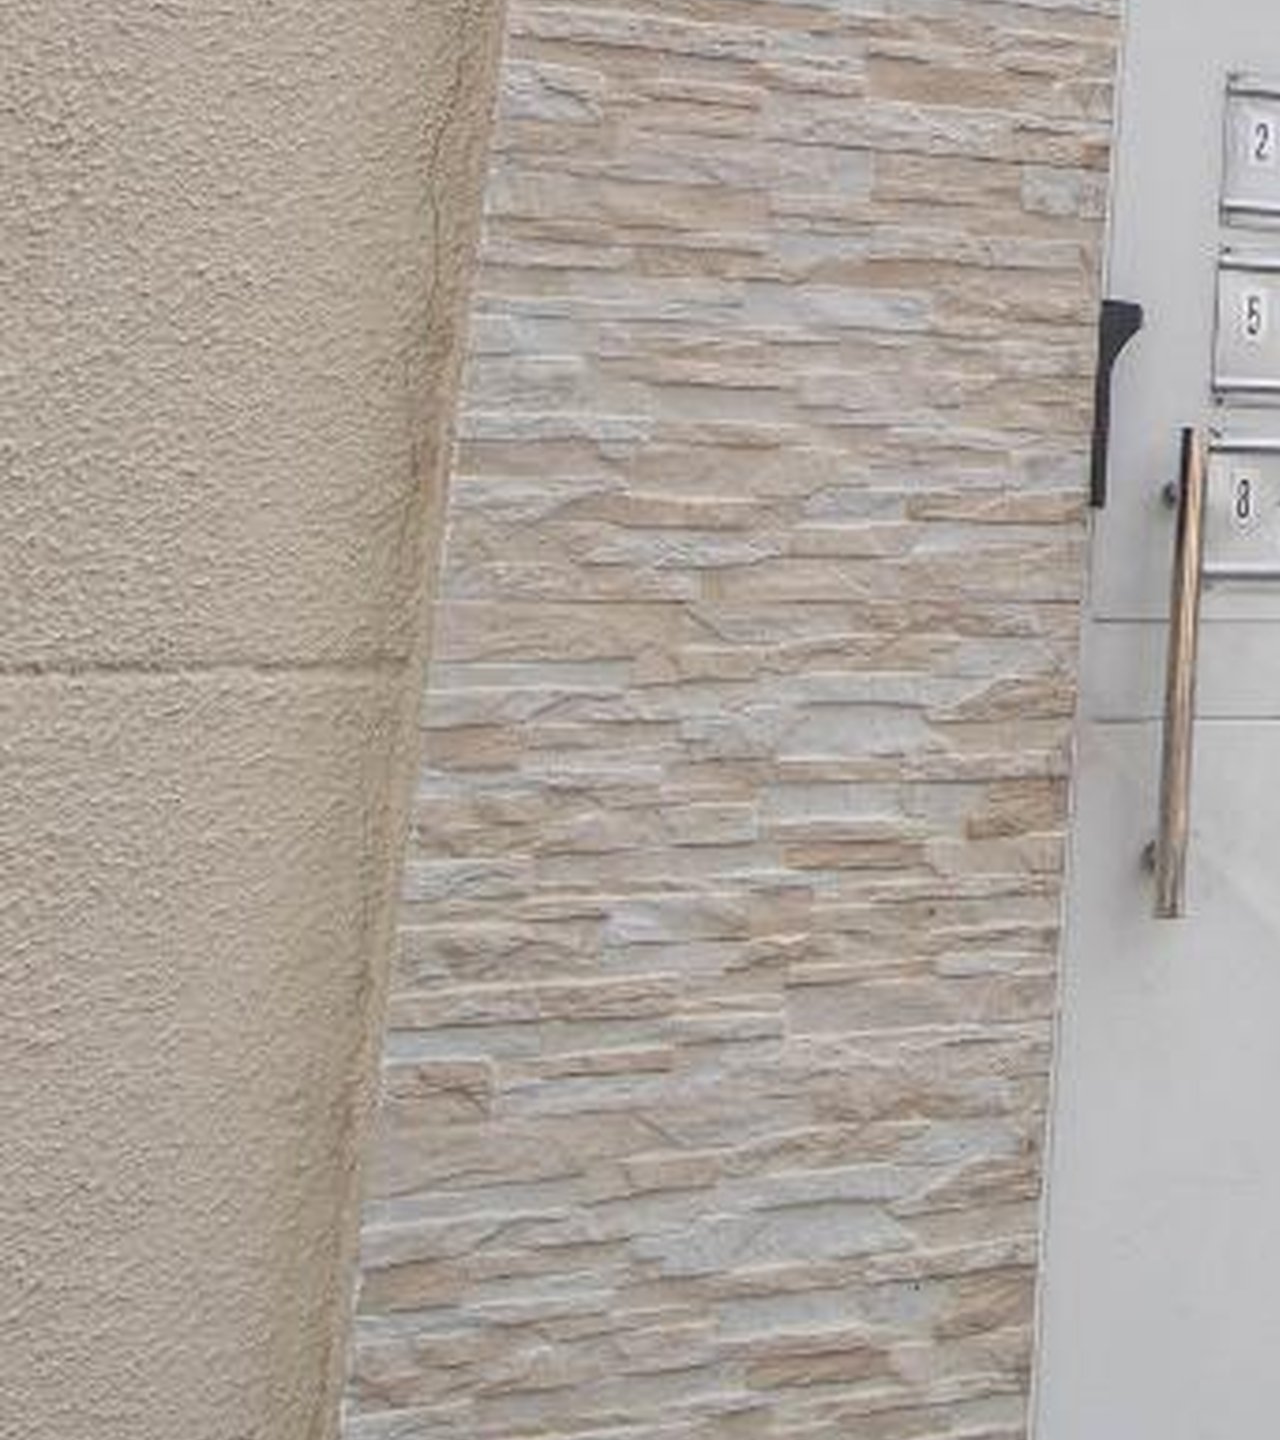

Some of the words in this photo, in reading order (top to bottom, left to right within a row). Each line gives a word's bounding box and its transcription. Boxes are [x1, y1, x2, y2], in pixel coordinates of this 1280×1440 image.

[1254, 122, 1270, 161] 2
[1245, 295, 1261, 336] 5
[1235, 477, 1251, 519] 8
